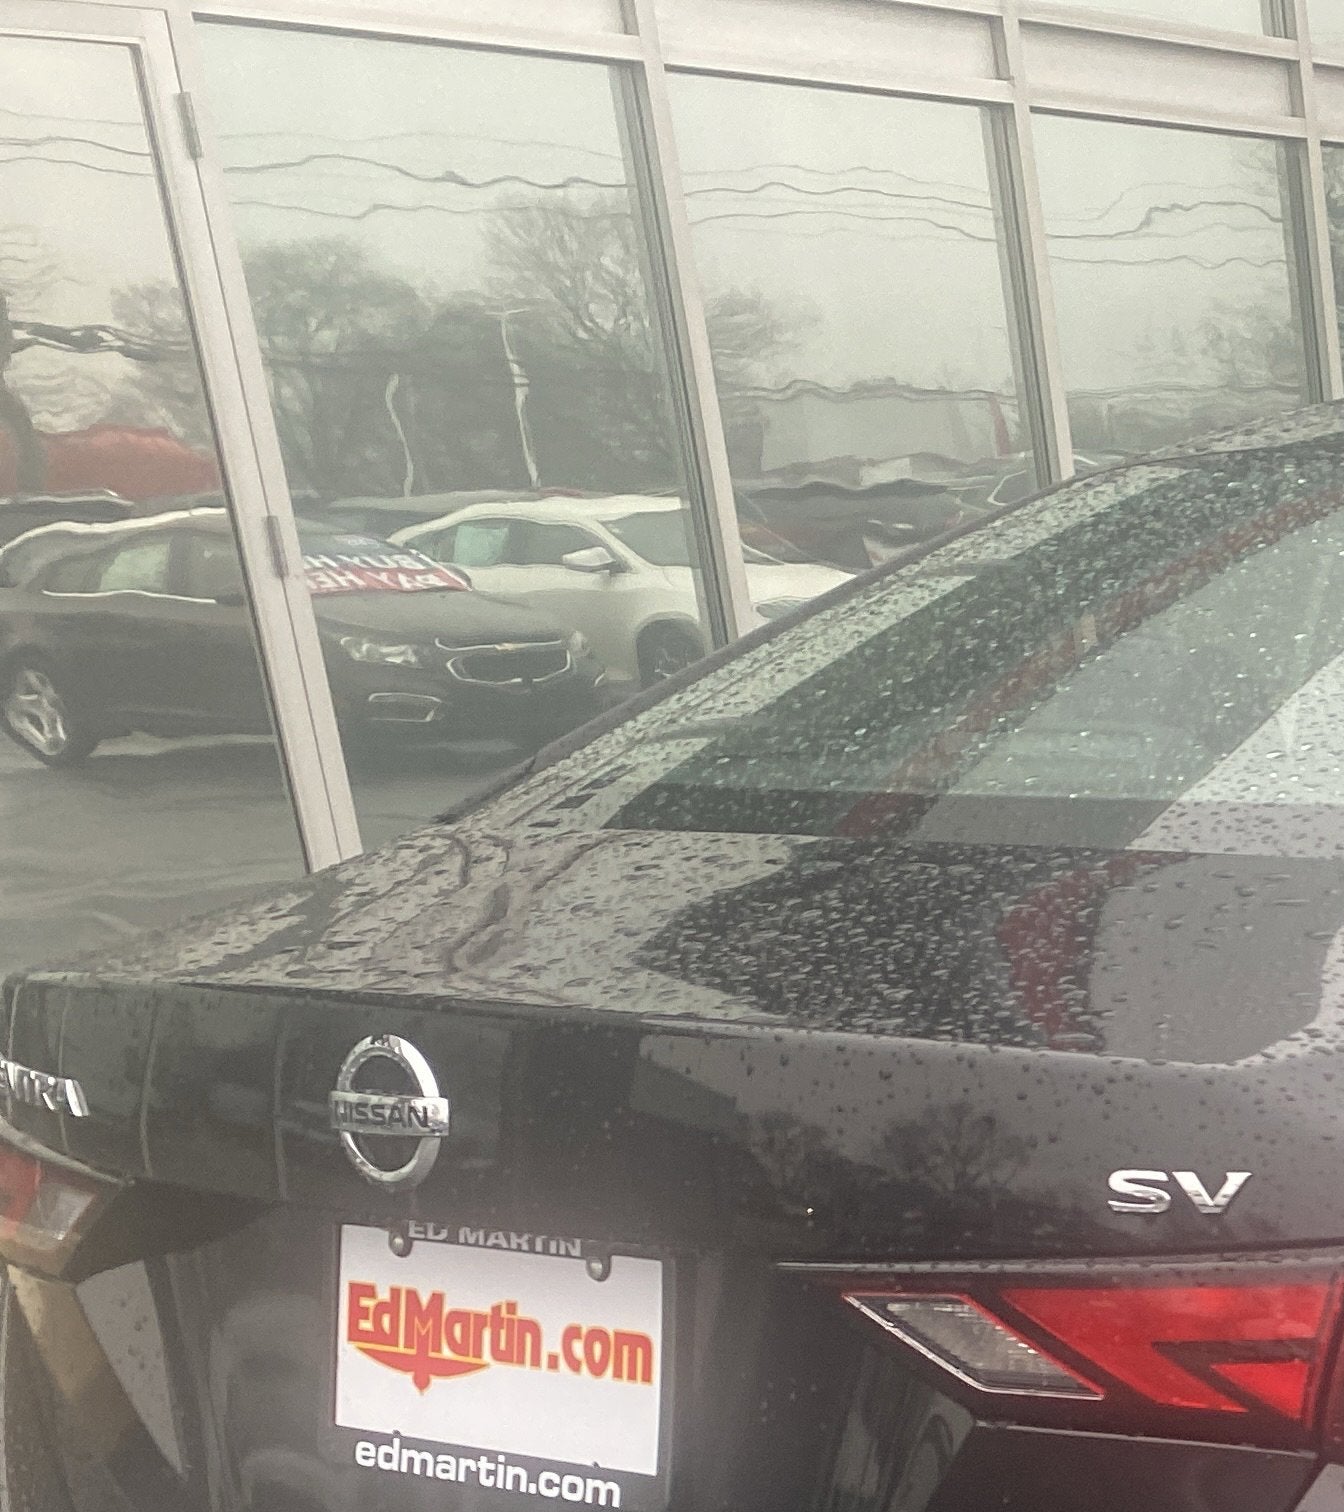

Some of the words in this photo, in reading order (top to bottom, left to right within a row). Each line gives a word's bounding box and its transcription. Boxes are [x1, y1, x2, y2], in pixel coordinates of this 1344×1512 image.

[334, 1100, 430, 1129] NISSAN
[1107, 1169, 1254, 1214] SV
[407, 1219, 449, 1242] ED
[457, 1226, 583, 1258] MARTIN
[345, 1279, 656, 1390] EdMartin.com
[353, 1437, 622, 1509] edmartin.com
